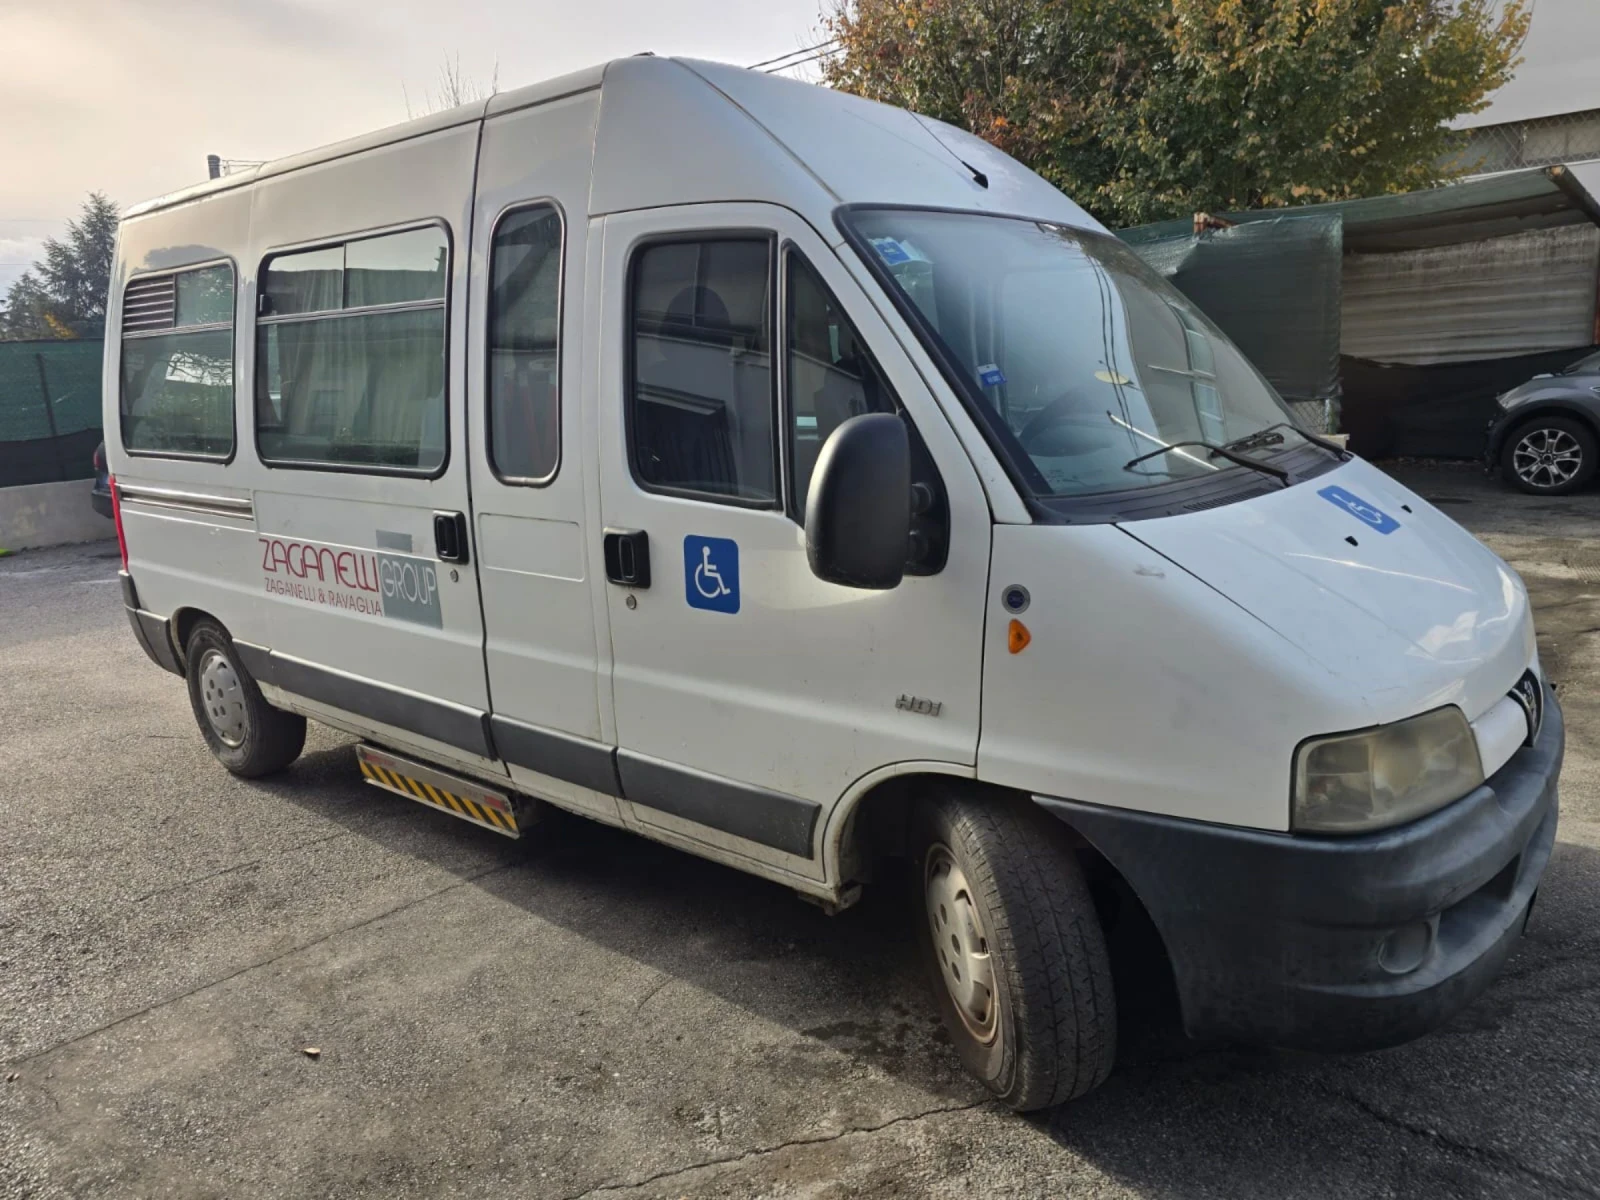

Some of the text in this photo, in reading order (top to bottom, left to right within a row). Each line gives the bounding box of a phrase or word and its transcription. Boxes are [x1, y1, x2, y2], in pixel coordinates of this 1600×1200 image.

[259, 538, 437, 606] ZAGANELLI GROUP
[265, 577, 383, 617] ZAGANELLI & RAVAGLIA
